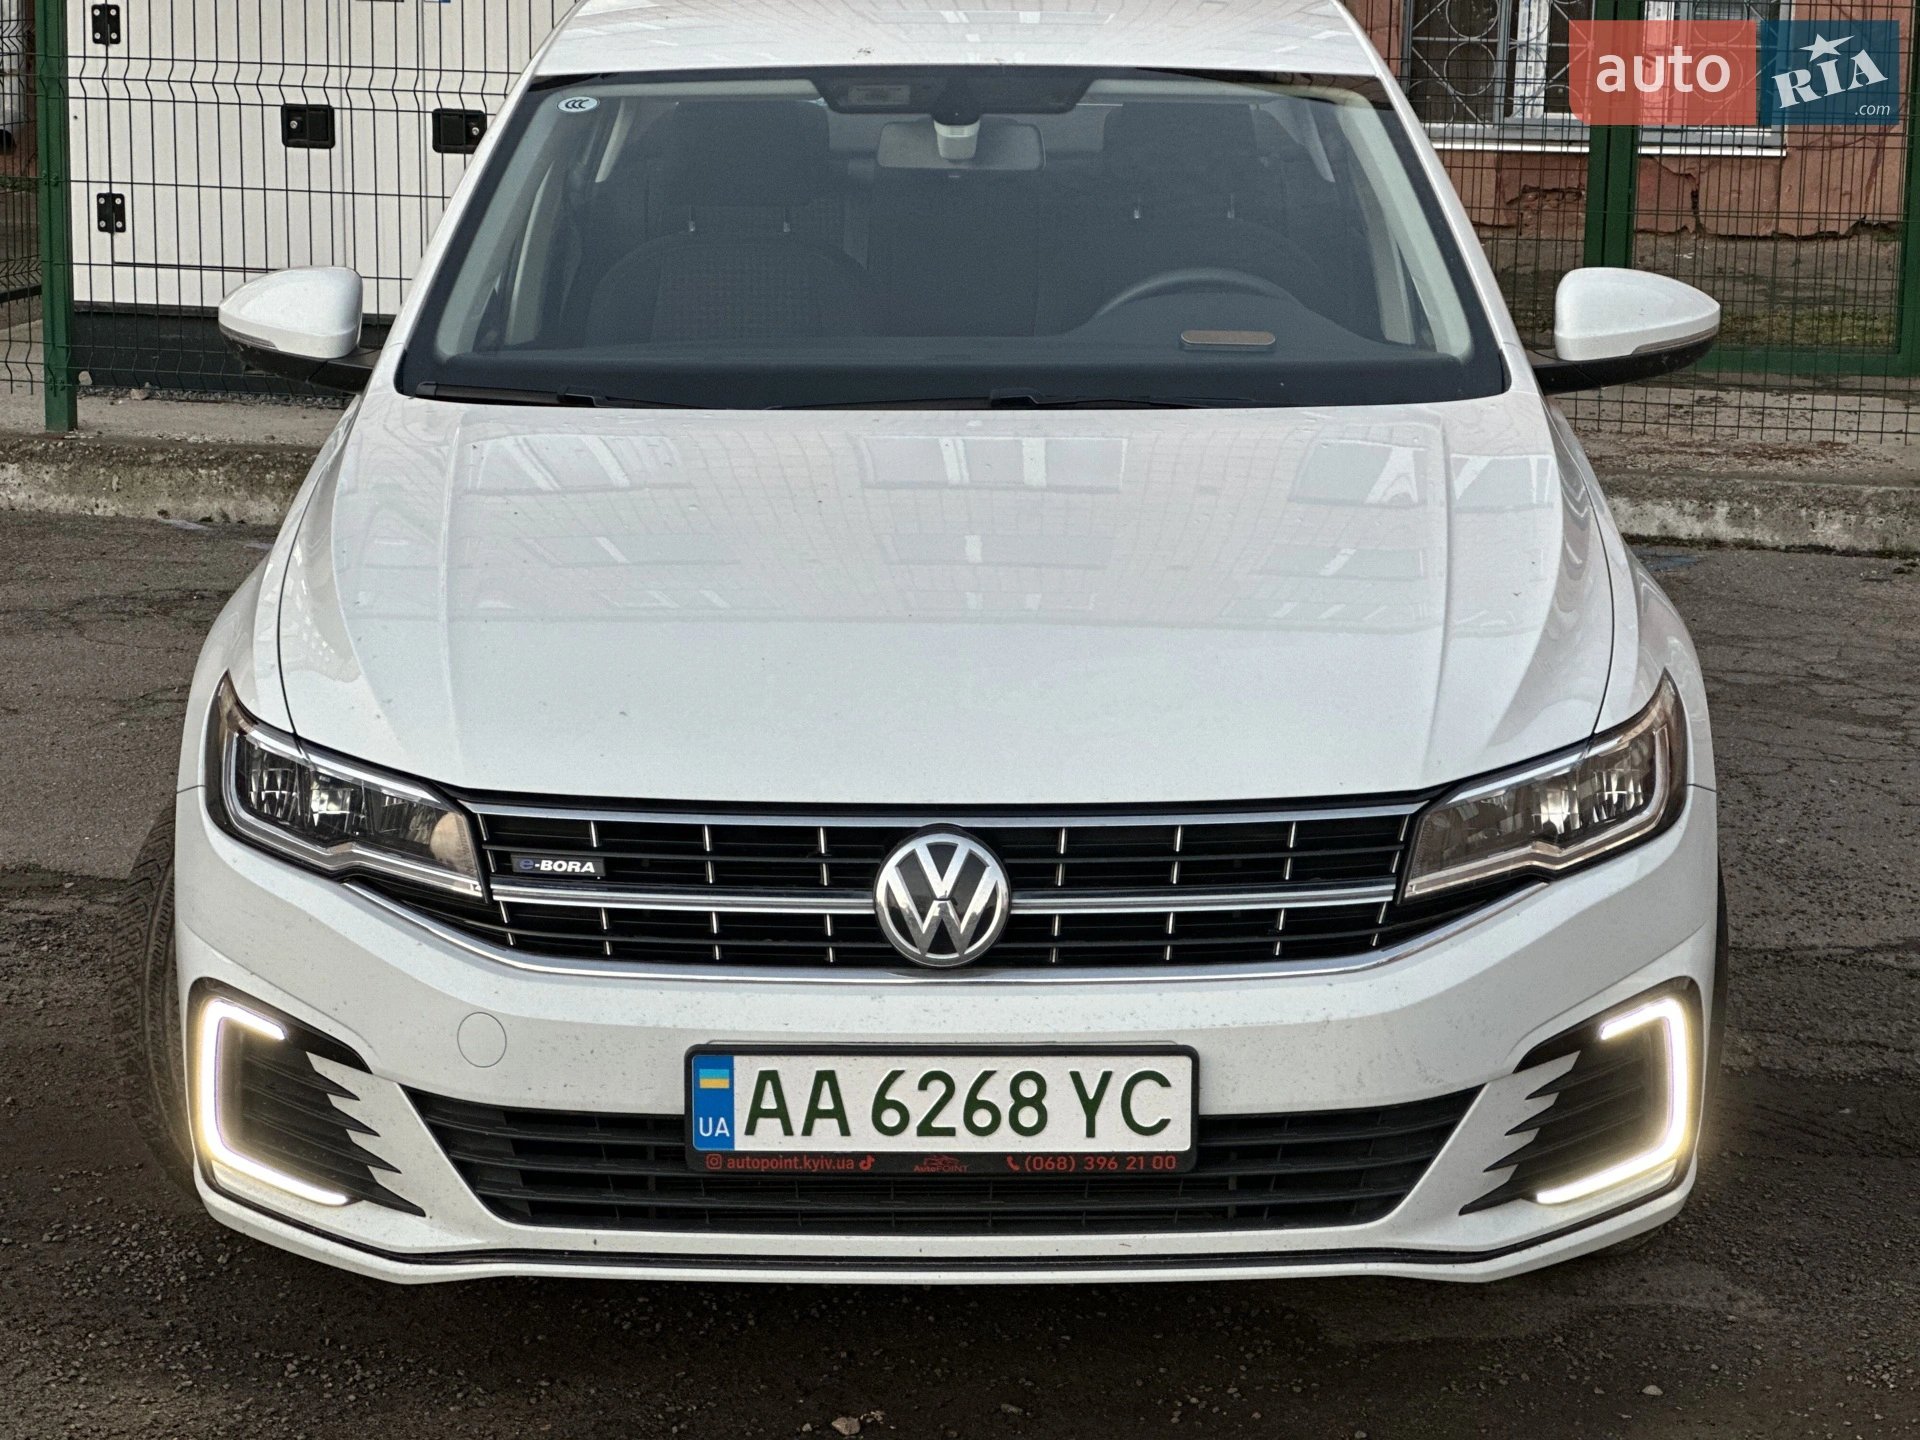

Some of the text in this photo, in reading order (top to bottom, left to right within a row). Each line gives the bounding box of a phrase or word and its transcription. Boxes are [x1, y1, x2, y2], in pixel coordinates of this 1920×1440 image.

[520, 859, 595, 873] e-BORA
[744, 1069, 1172, 1138] AA 6268 YC
[699, 1116, 730, 1138] UA
[726, 1155, 855, 1172] autopoint.kyiv.ua
[1024, 1155, 1177, 1172] (068) 396 21 00
